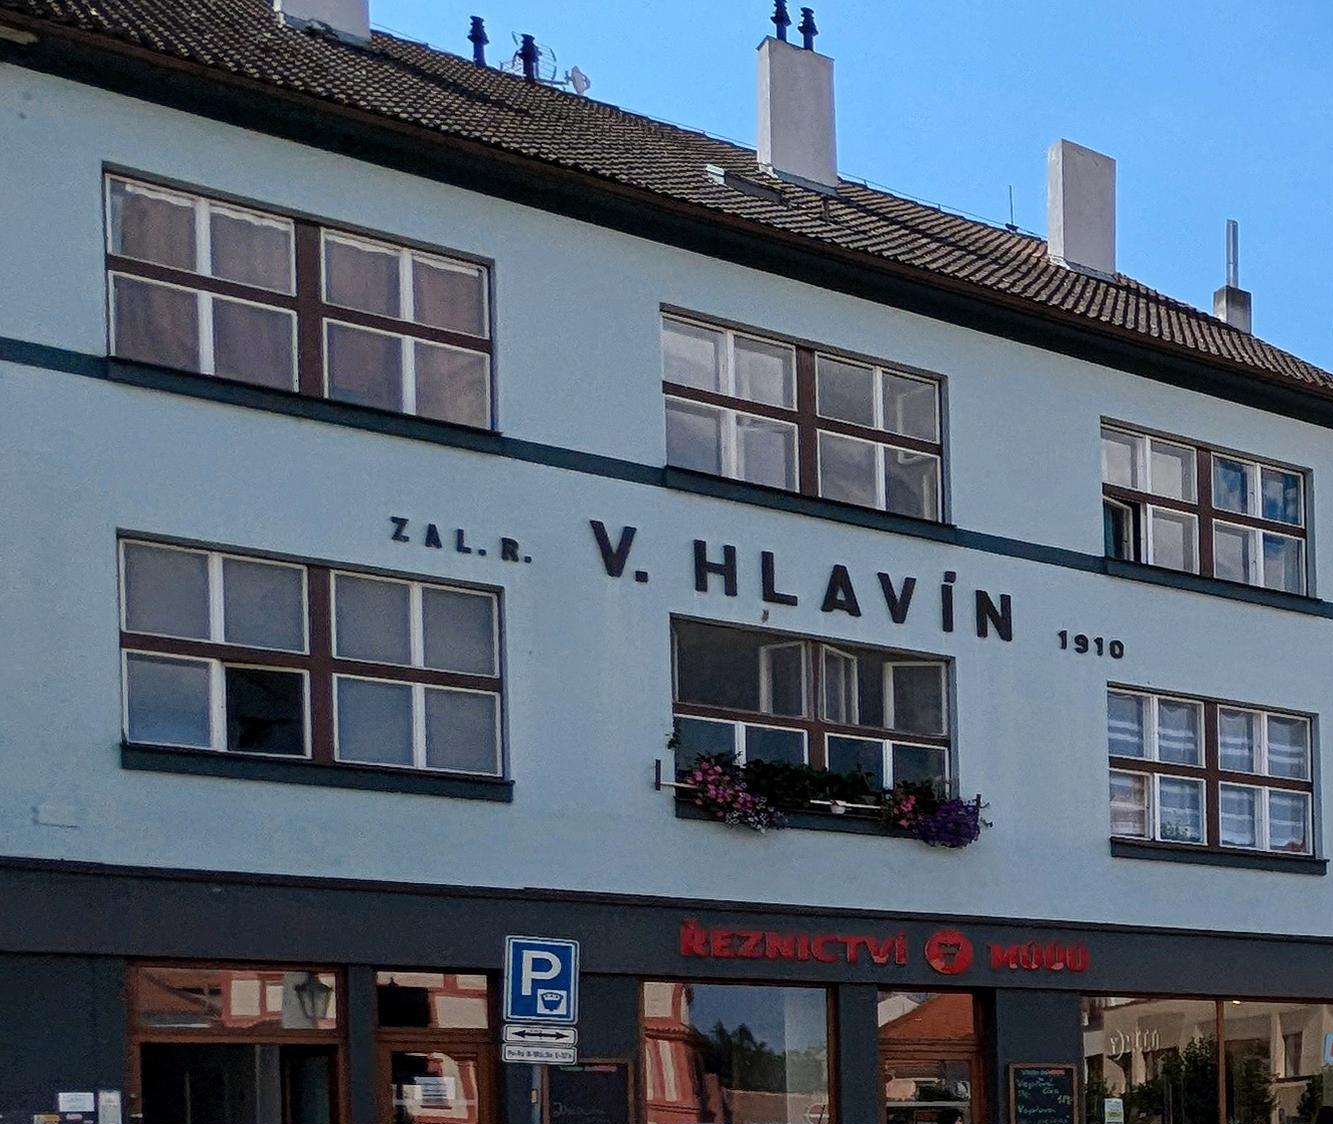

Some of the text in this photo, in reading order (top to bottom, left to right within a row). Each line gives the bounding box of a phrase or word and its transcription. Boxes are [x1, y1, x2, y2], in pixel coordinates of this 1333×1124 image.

[590, 519, 1014, 642] V. HLAVÍN
[1057, 629, 1126, 660] 1910
[679, 917, 908, 967] ŘEZNICTVÍ
[522, 950, 562, 995] P
